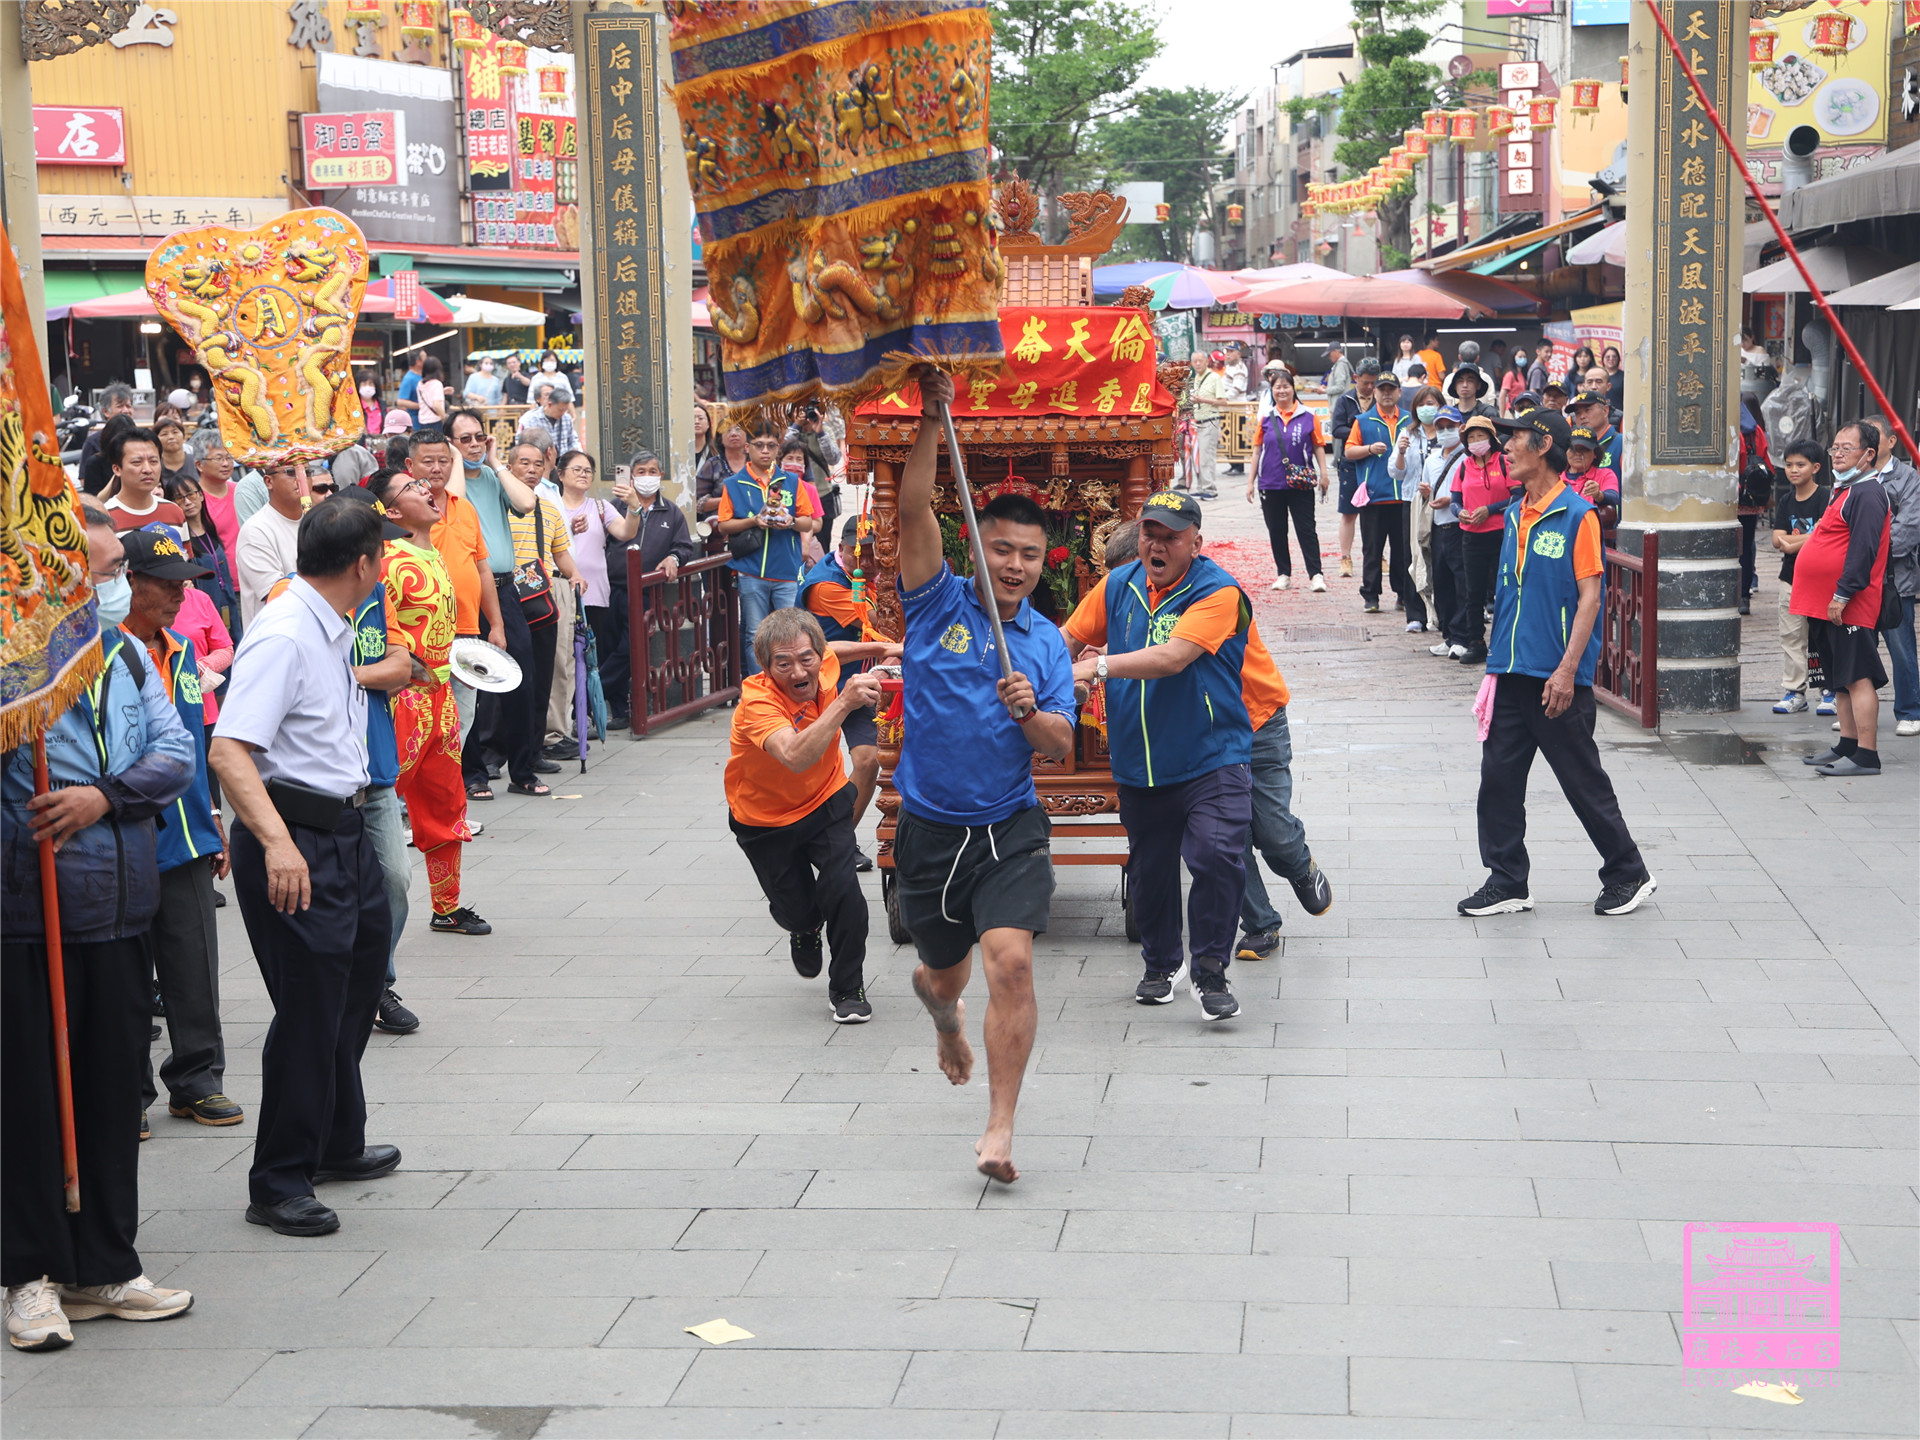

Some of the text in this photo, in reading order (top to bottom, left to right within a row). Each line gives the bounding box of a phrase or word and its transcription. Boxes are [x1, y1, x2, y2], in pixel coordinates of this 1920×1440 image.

[34, 112, 99, 157] 店
[315, 120, 384, 151] 御品齋
[469, 109, 506, 129] 總店
[469, 136, 508, 156] 百年老店
[392, 211, 413, 220] Creative
[252, 294, 287, 341] 月
[998, 313, 1153, 364] 崙天倫
[881, 377, 1153, 414] 聖母進香團
